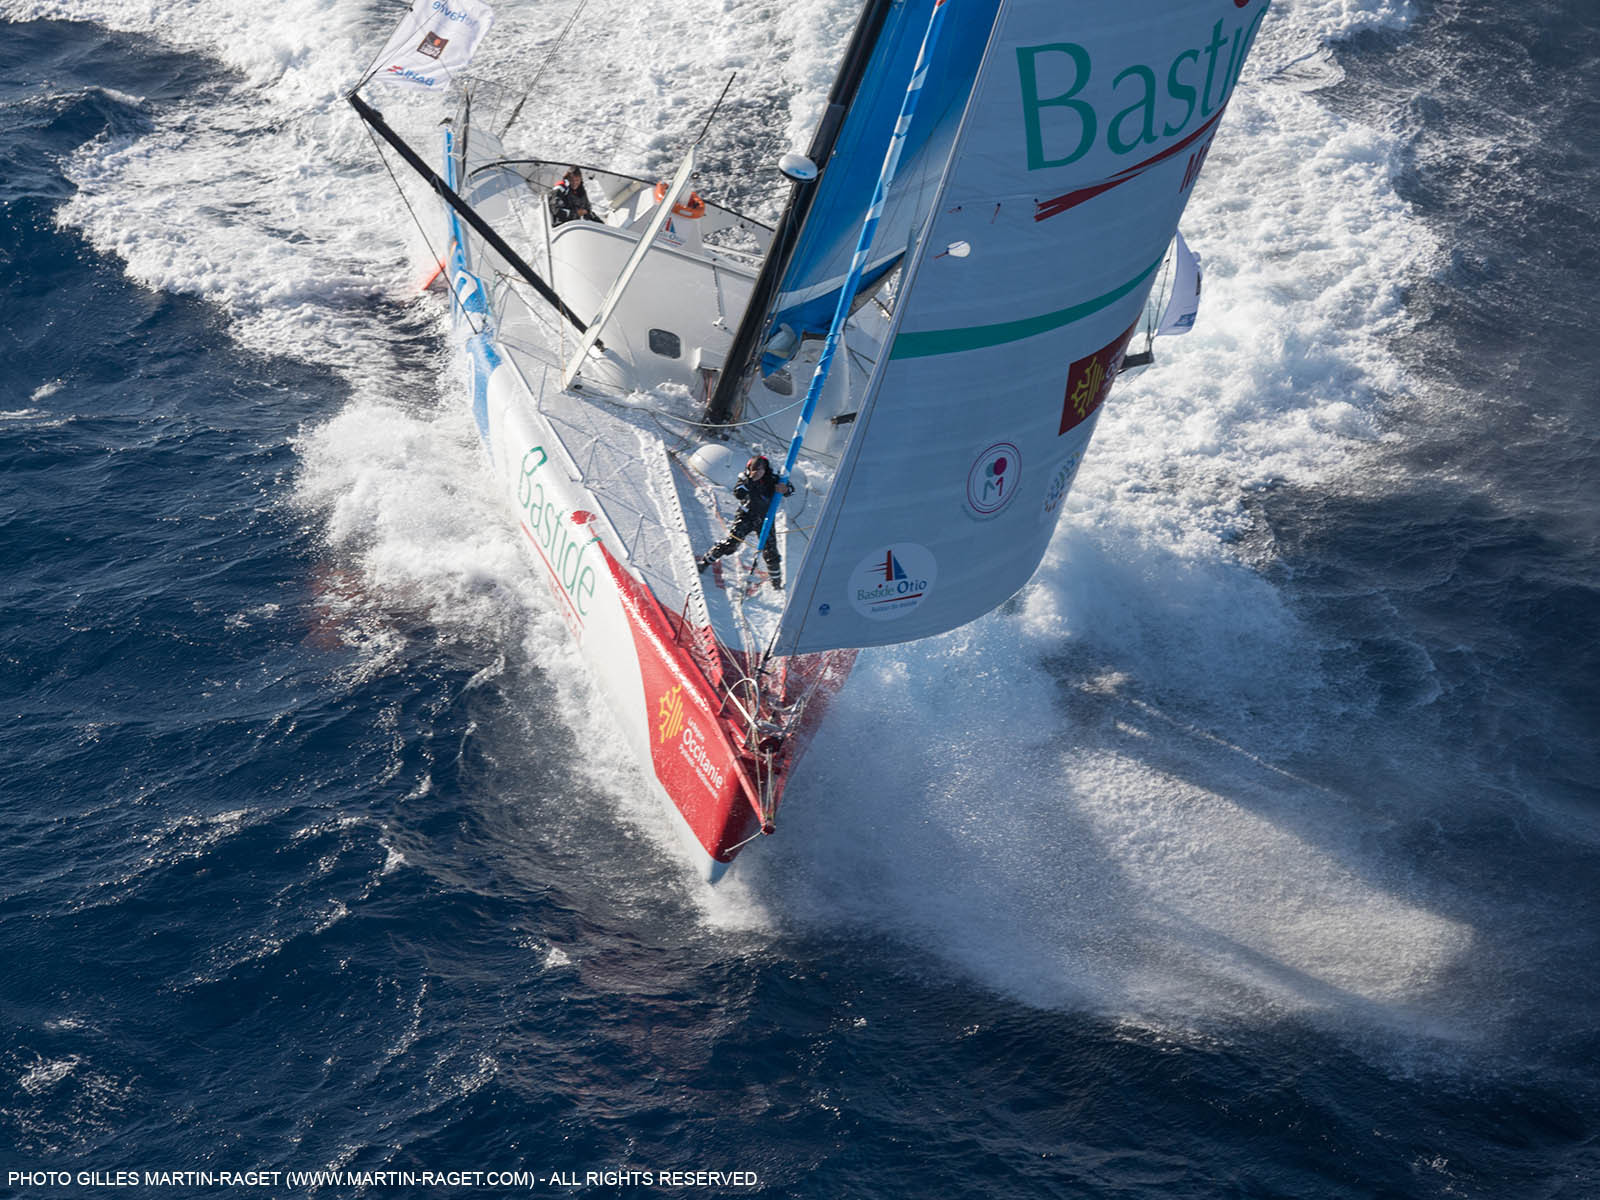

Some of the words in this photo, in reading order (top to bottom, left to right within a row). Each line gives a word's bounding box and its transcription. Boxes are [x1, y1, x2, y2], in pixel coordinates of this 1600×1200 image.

[518, 446, 602, 616] Bastide
[897, 580, 927, 594] Otio
[682, 727, 724, 790] Occitanie
